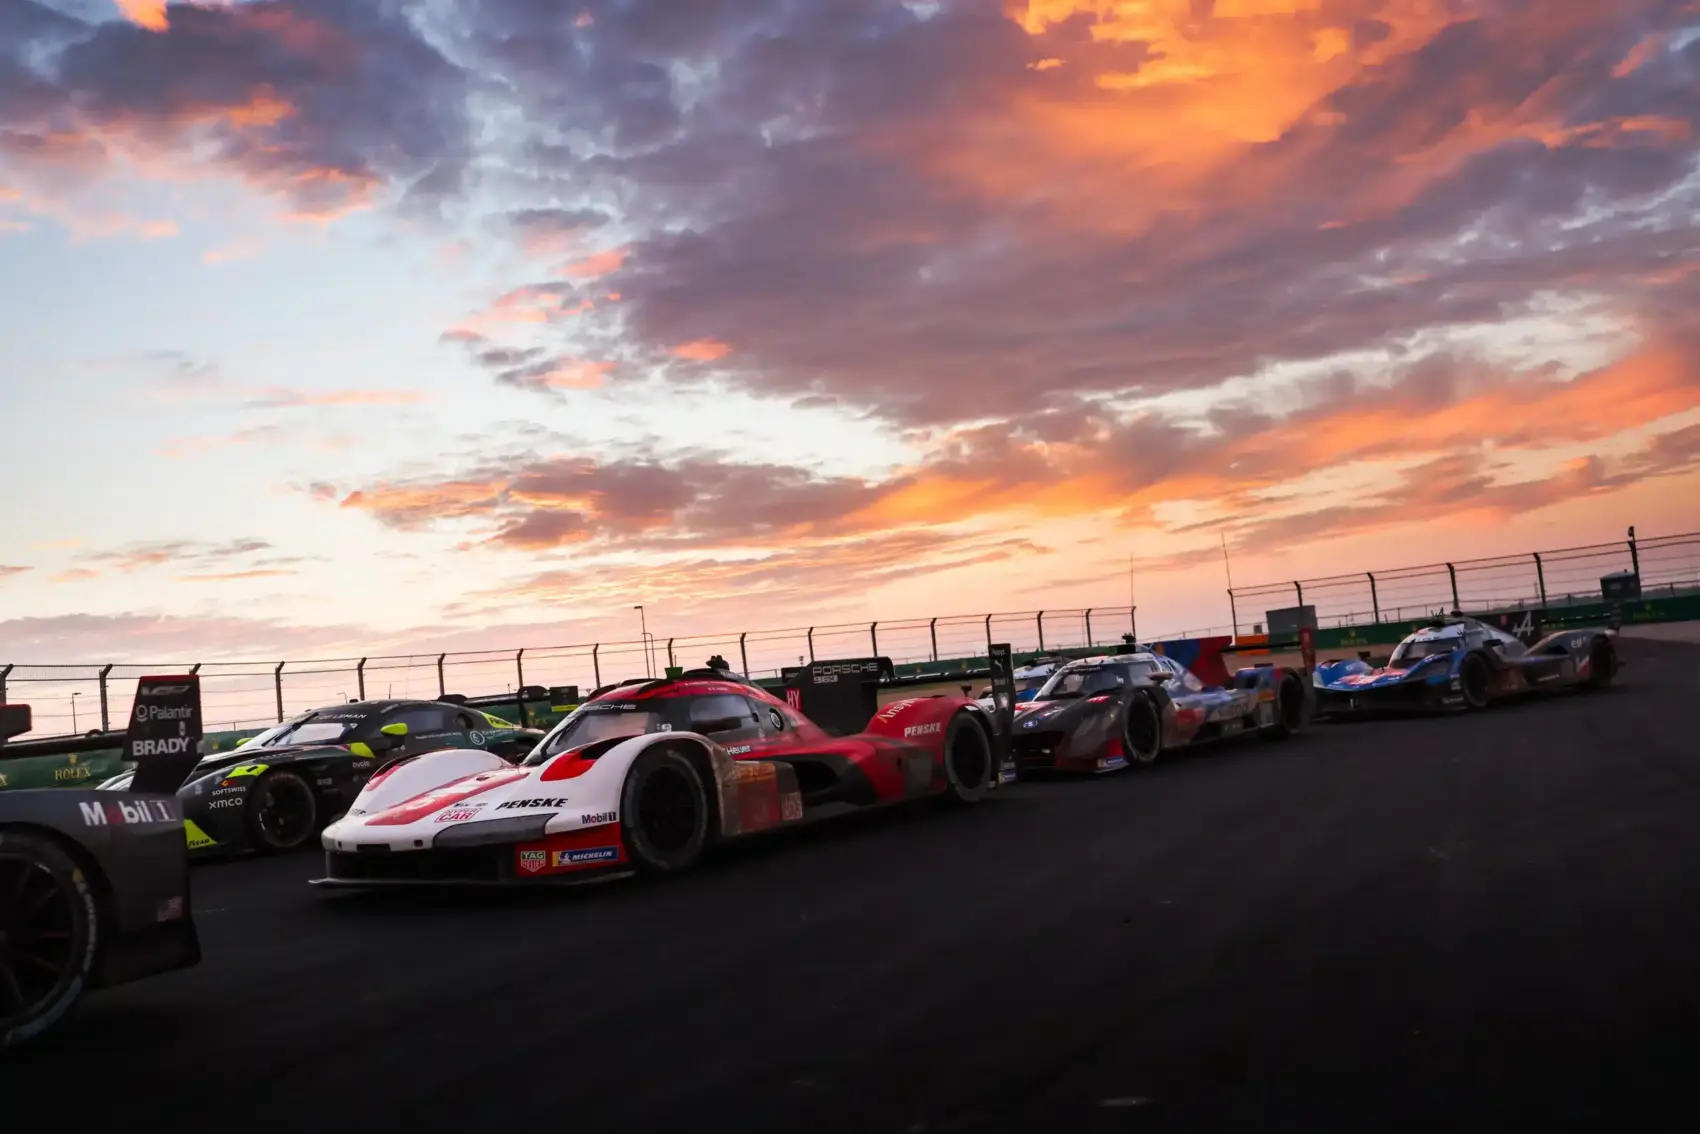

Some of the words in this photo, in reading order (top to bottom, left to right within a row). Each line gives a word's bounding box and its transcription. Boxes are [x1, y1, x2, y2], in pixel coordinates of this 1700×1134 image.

[813, 663, 878, 677] PORSCHE
[814, 675, 838, 684] 963
[787, 690, 800, 709] HY
[149, 704, 193, 719] Palantir
[904, 722, 941, 737] PENSKE
[132, 737, 190, 756] BRADY
[726, 745, 752, 755] Heuer
[54, 766, 91, 780] ROLEX
[212, 786, 246, 796] SOFTSWISS
[208, 797, 243, 810] xmco
[495, 798, 568, 810] PENSKE
[78, 800, 153, 827] Mobil
[440, 812, 472, 821] CAR
[582, 814, 607, 824] Mobil
[608, 812, 616, 821] 1
[572, 851, 613, 861] MICHELIN
[521, 859, 546, 872] HEUER
